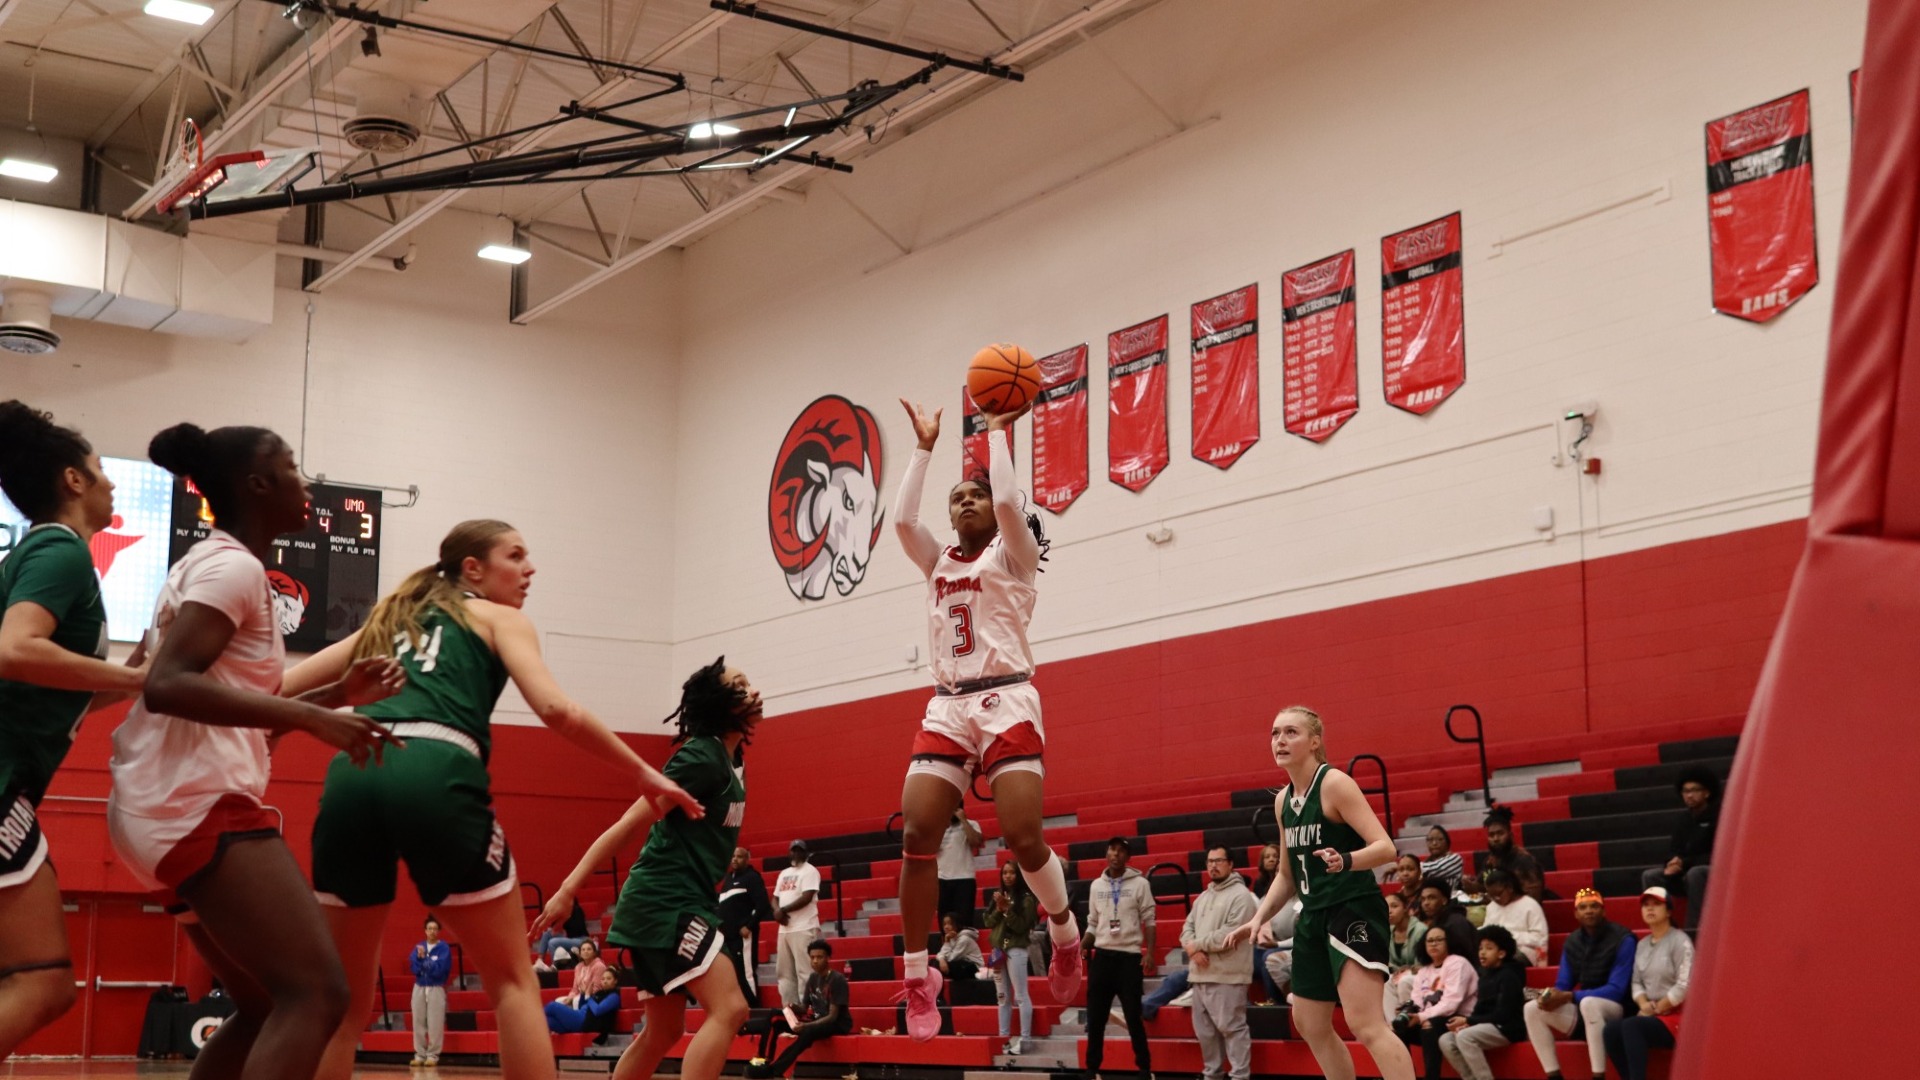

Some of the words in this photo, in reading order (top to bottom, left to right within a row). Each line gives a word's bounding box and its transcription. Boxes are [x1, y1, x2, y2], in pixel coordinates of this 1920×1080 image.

[1407, 263, 1435, 280] FOOTBALL
[1742, 288, 1790, 314] RAMS
[1407, 386, 1443, 406] RAMS
[1209, 442, 1241, 460] RAMS
[1124, 466, 1151, 484] RAMS
[344, 498, 365, 513] UMO
[1047, 488, 1073, 506] RAMS
[176, 528, 189, 537] PLY
[198, 520, 213, 530] BON
[319, 517, 330, 534] 4
[359, 513, 374, 540] 3
[271, 538, 291, 548] RIOD
[294, 540, 317, 551] FOULS
[330, 535, 356, 546] BONUS
[330, 544, 343, 553] PLY
[346, 546, 360, 555] FLS
[362, 547, 376, 557] PTS
[935, 576, 982, 607] Rams
[949, 603, 975, 657] 3
[1299, 823, 1322, 847] OLIVE
[1297, 854, 1310, 895] 3
